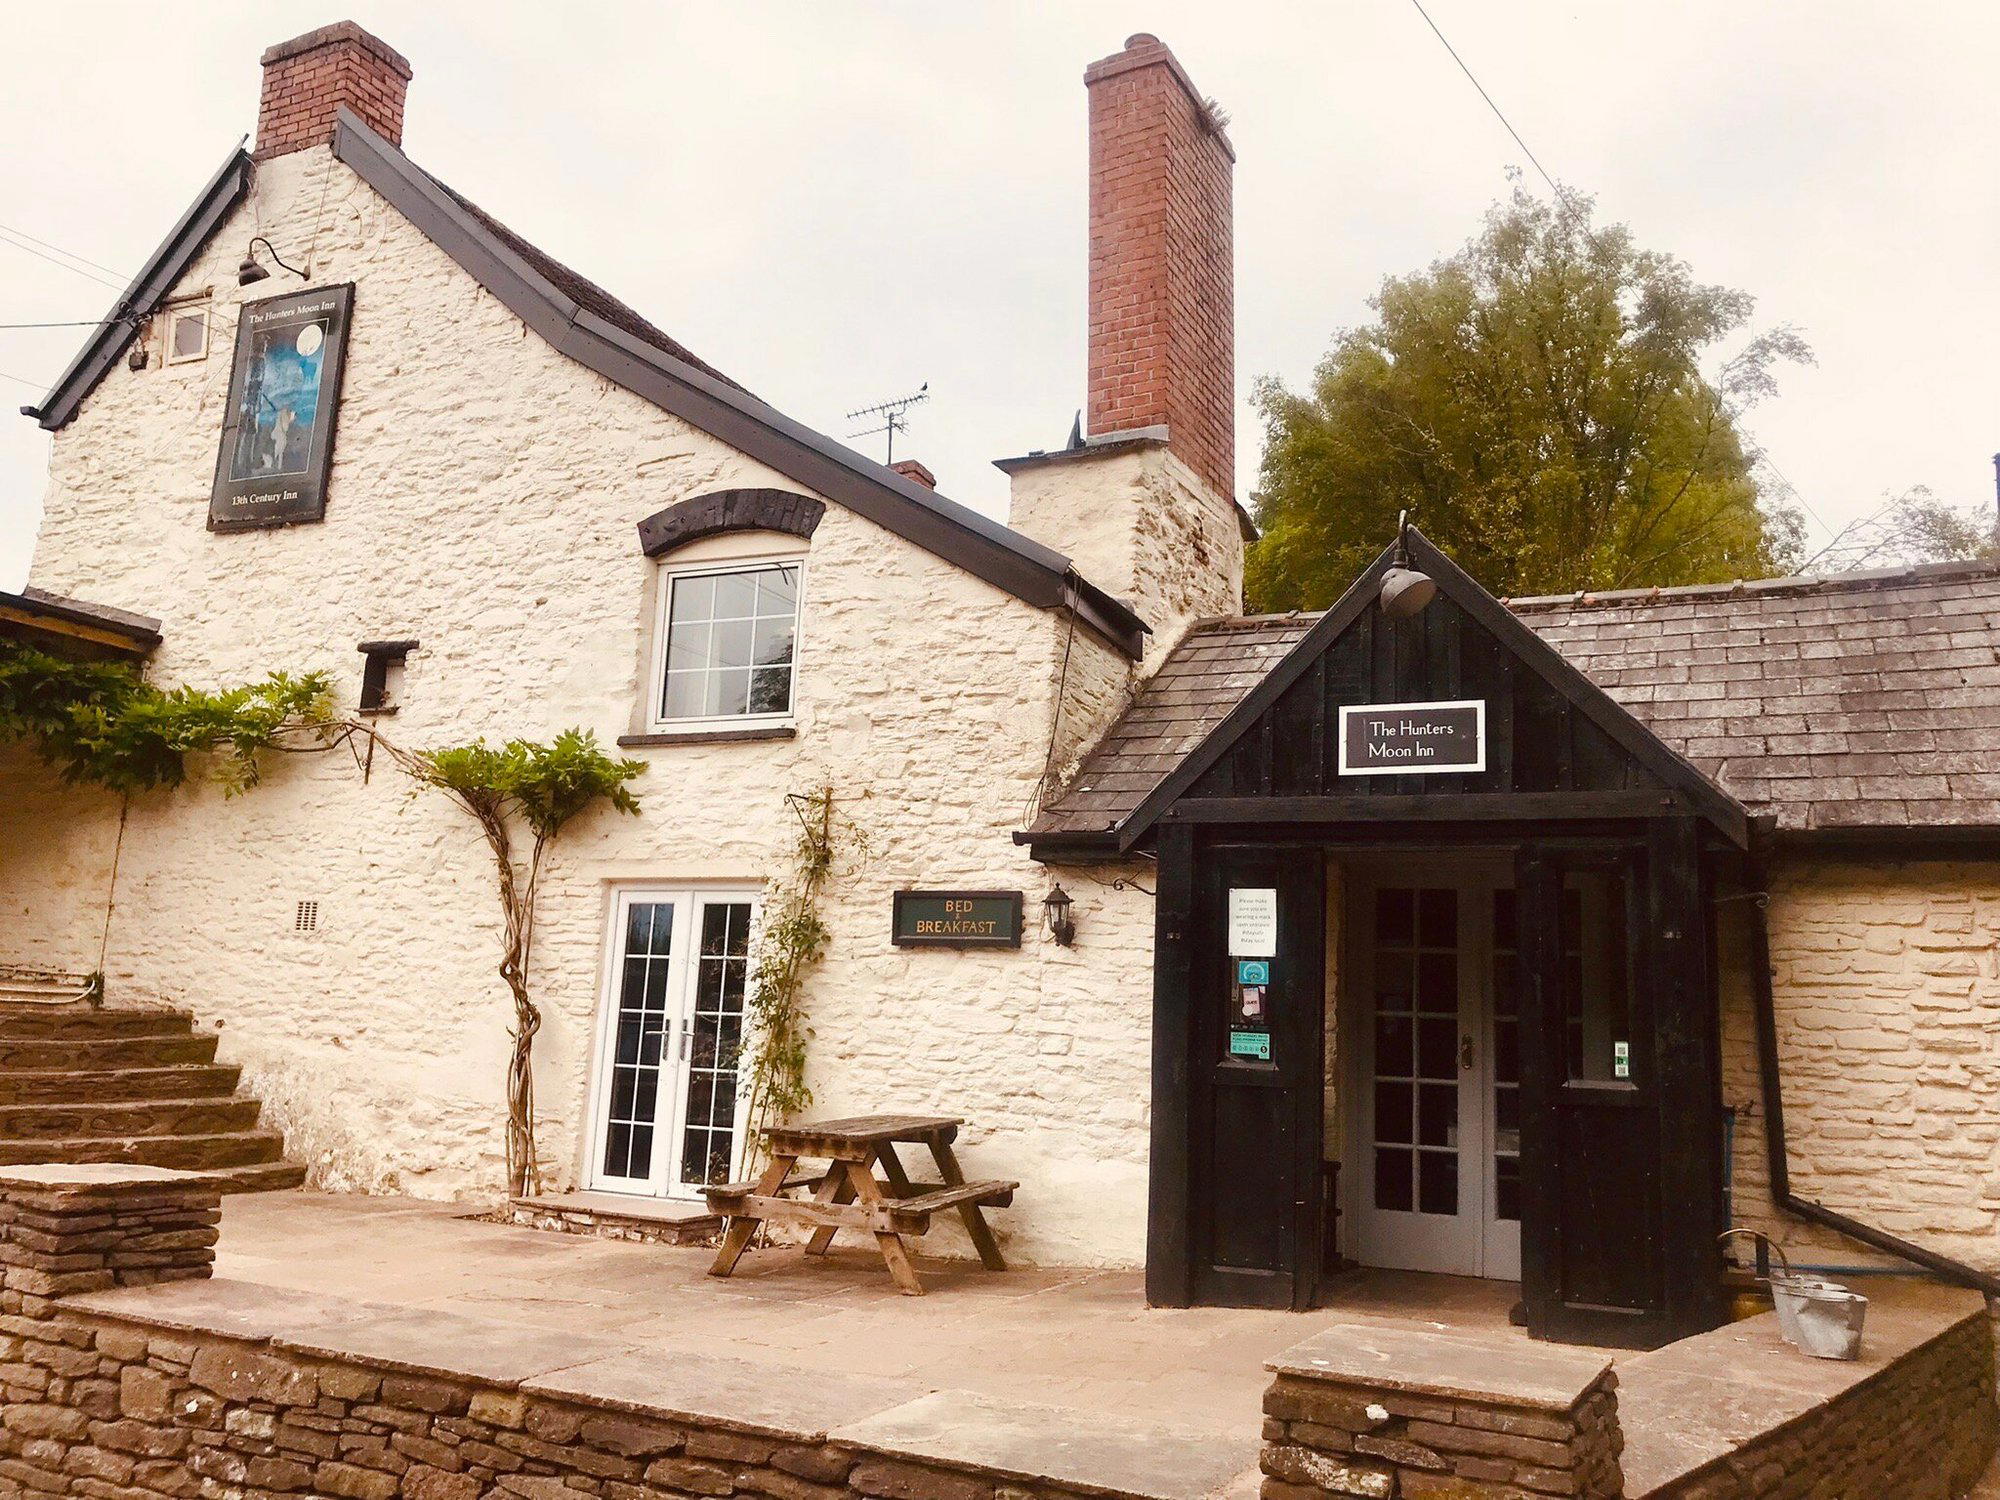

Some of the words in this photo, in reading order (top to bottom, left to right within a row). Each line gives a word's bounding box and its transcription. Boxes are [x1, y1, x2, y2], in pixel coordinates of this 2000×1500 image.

[248, 313, 264, 324] The
[265, 308, 296, 322] Hunters
[296, 305, 320, 315] Moon
[320, 301, 336, 310] Inn
[231, 495, 249, 506] 13th
[249, 492, 282, 506] Century
[283, 490, 298, 500] Inn
[1369, 721, 1396, 737] The
[1399, 719, 1454, 736] Hunters
[1368, 742, 1412, 758] Moon
[1416, 741, 1434, 757] Inn
[945, 900, 973, 913] BED
[916, 920, 997, 934] BREAKFAST
